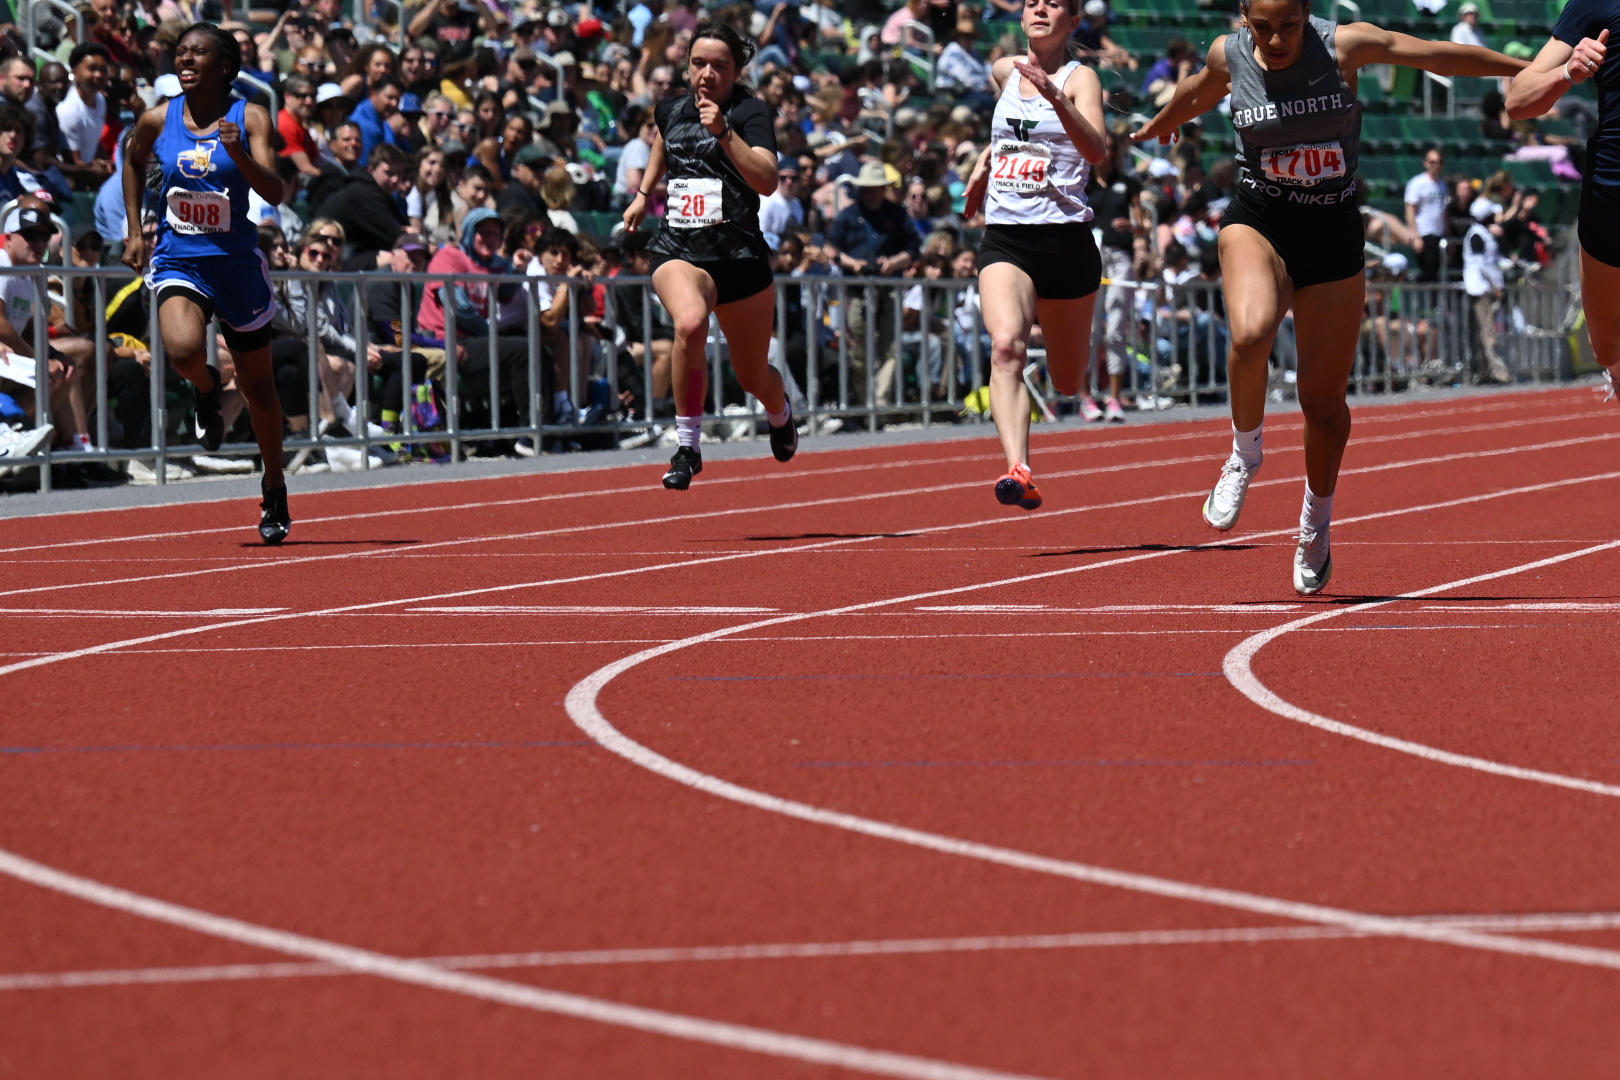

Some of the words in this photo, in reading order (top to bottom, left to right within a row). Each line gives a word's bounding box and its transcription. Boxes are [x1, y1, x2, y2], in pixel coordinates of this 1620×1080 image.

[1235, 103, 1278, 126] TRUE
[1280, 93, 1343, 117] NORTH
[994, 155, 1046, 182] 2149
[1268, 149, 1342, 177] 1704
[995, 180, 1014, 188] TRACK
[1021, 182, 1041, 190] FIELD
[1276, 176, 1303, 185] TRACK
[681, 194, 705, 217] 20
[1288, 190, 1338, 206] NIKE
[179, 201, 220, 226] 908
[173, 223, 196, 232] TRACK
